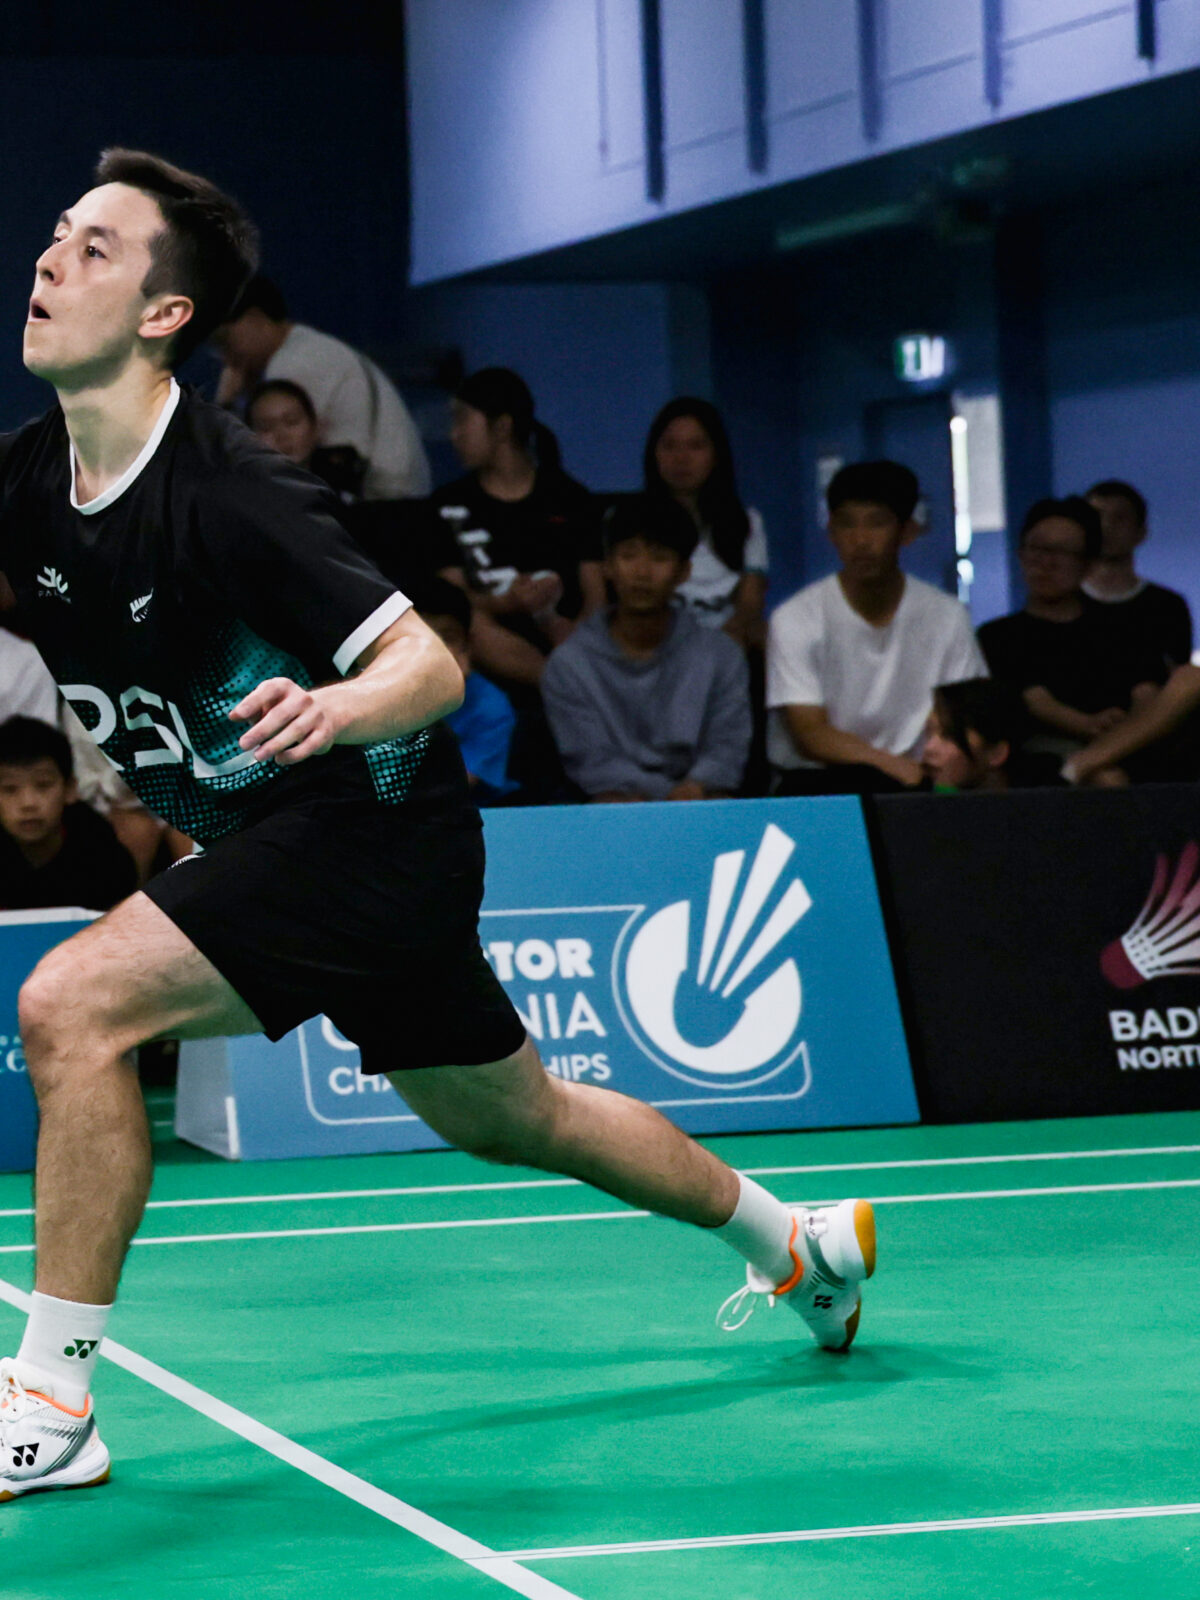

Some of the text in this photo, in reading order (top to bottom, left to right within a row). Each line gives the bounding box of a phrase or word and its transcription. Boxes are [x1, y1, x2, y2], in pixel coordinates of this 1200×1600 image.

[484, 938, 595, 981] TOR
[1109, 1006, 1200, 1042] BAD
[1117, 1044, 1200, 1071] NORT
